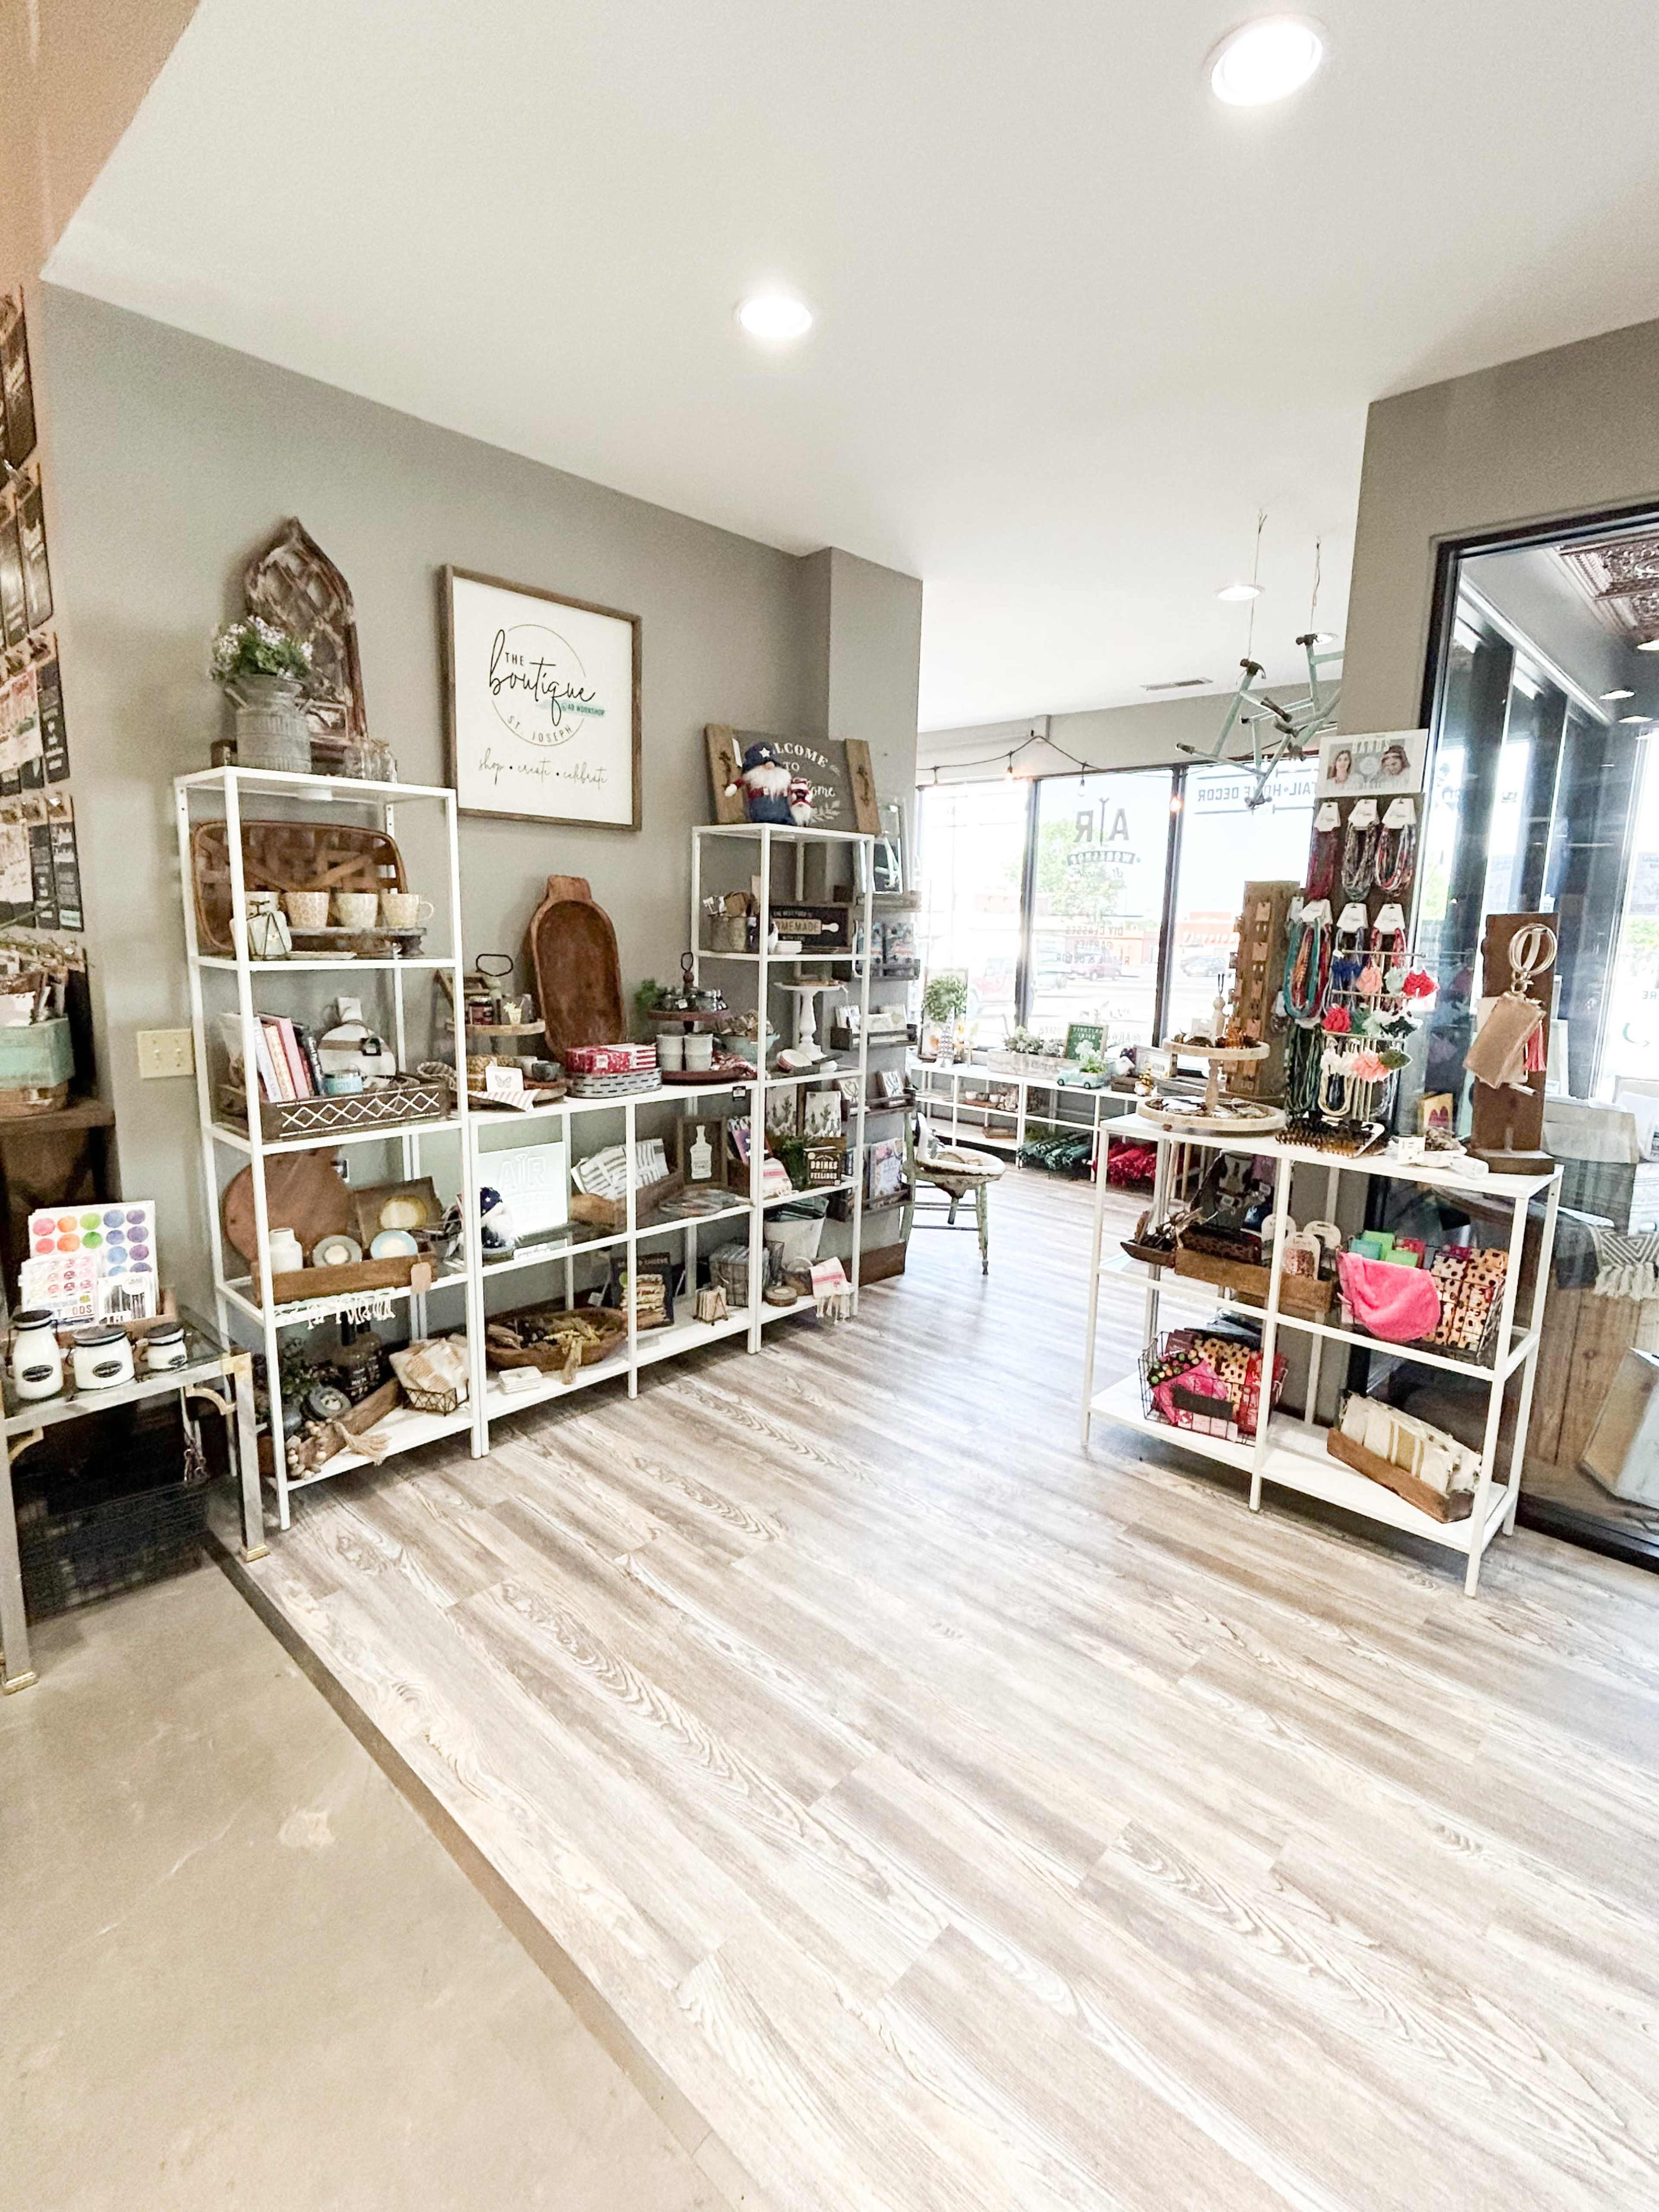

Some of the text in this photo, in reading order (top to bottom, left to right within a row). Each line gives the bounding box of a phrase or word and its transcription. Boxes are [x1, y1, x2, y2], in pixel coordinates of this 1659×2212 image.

[505, 652, 524, 666] THE
[489, 629, 596, 726] boutique
[576, 705, 605, 716] WORKSHOP
[531, 725, 573, 743] JOSEPH
[772, 742, 828, 768] LCOME
[478, 747, 505, 785] shop
[518, 759, 551, 783] create
[776, 920, 819, 932] MEMADE
[810, 1160, 838, 1170] DRINKS
